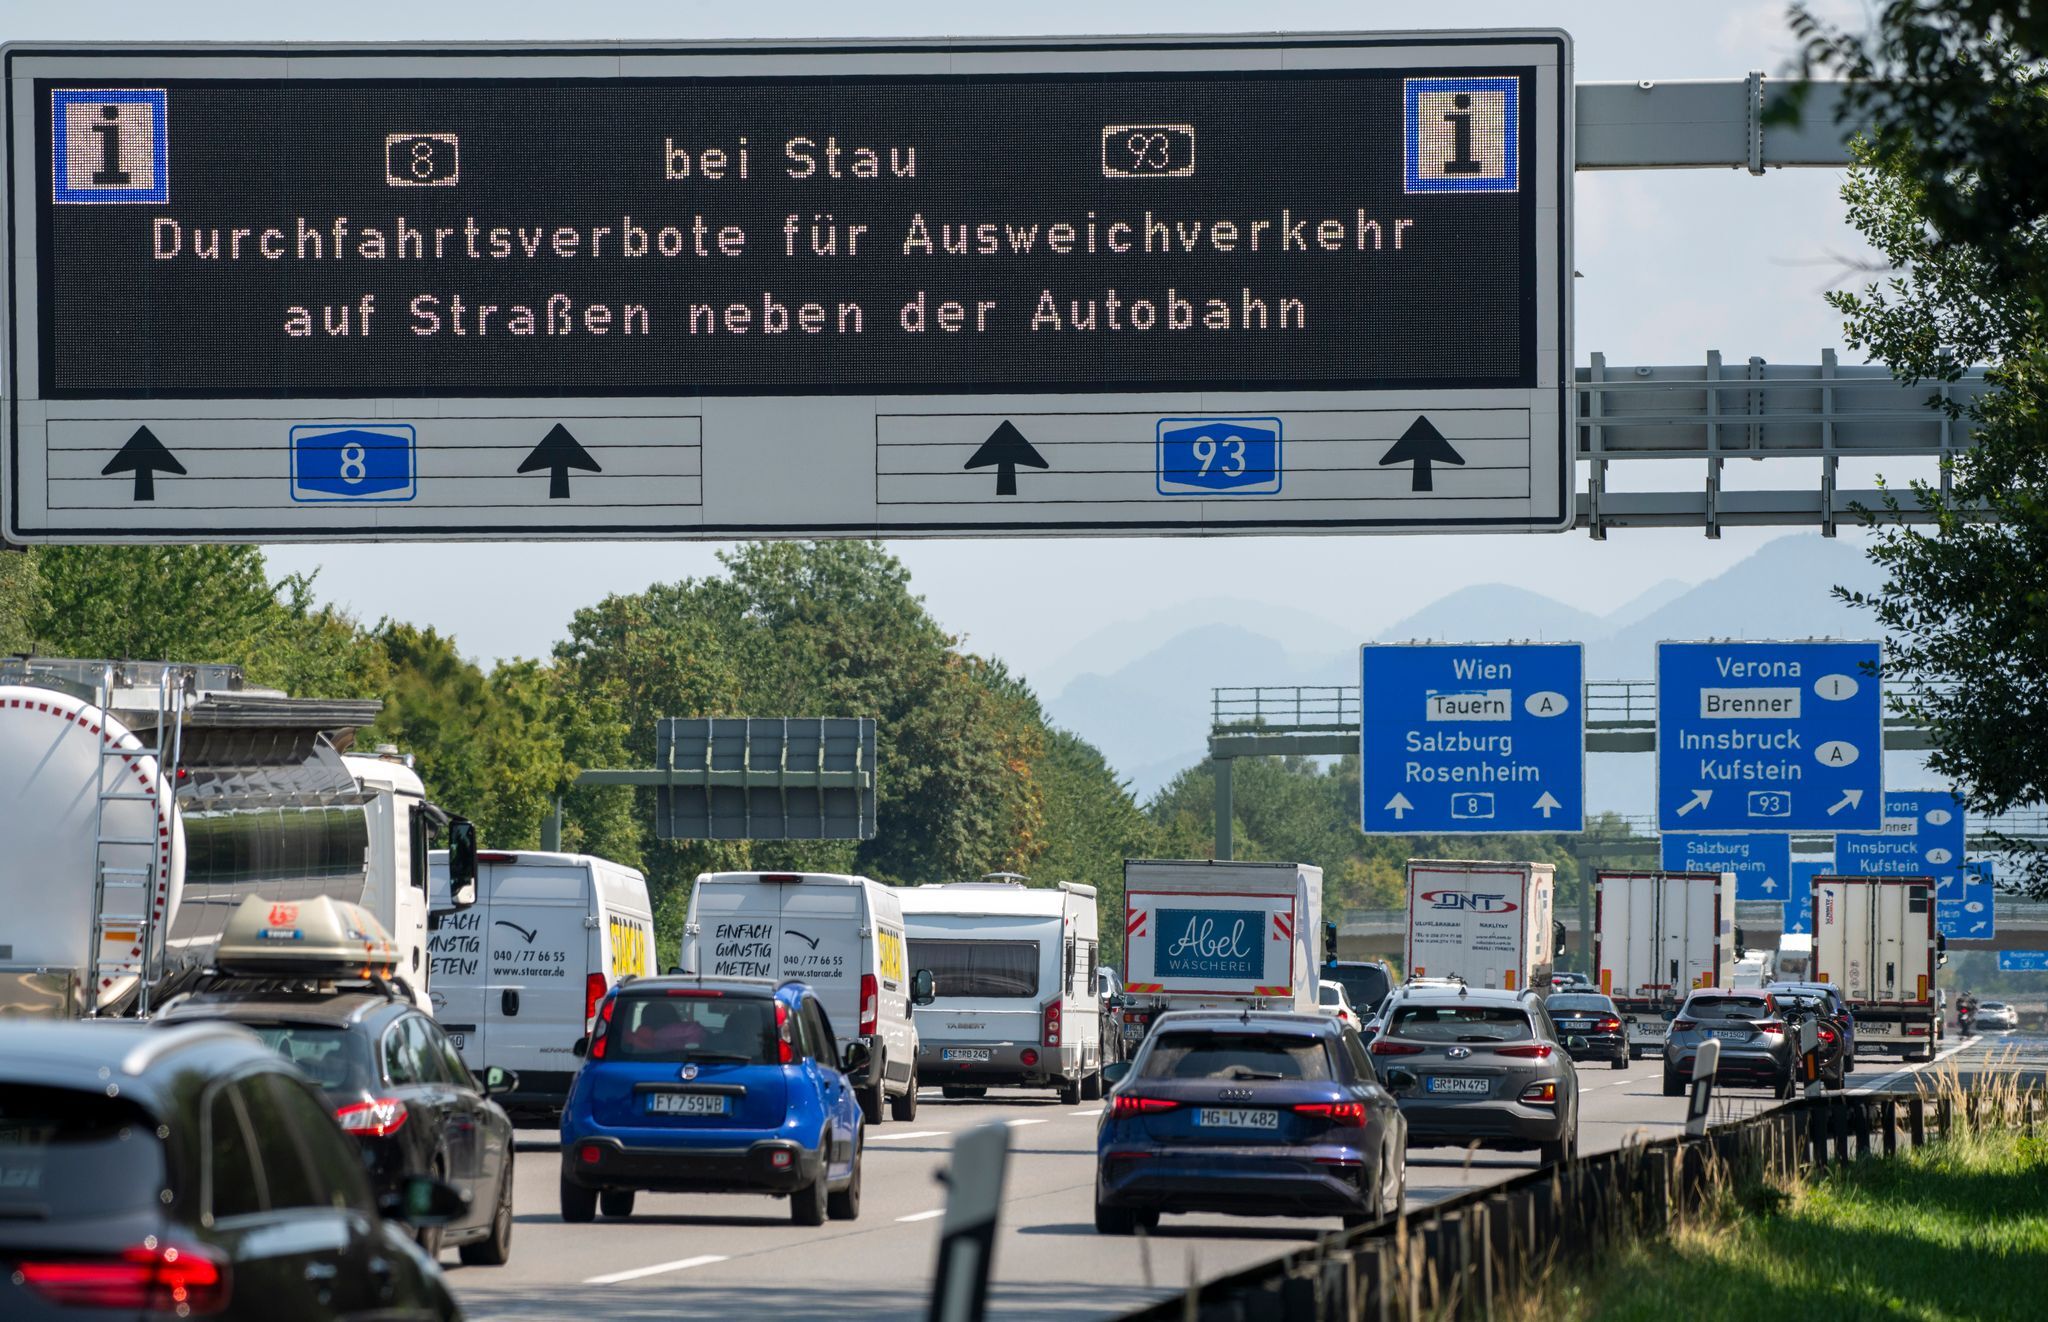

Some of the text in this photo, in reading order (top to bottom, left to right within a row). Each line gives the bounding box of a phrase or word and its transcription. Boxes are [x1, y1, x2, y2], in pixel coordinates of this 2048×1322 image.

[665, 136, 915, 180] bei Stau
[1128, 133, 1168, 169] 93
[412, 142, 433, 178] 8
[153, 208, 1414, 260] Durchfahrtsverbote für Ausweichverkehr
[283, 288, 1305, 337] auf Straßen neben der Autobahn
[341, 442, 366, 484] 8
[1193, 435, 1246, 477] 93
[1453, 658, 1512, 680] Wien
[1716, 656, 1801, 677] Verona
[1434, 696, 1505, 714] Tauern
[1540, 697, 1553, 713] A
[1707, 695, 1793, 713] Brenner
[1406, 731, 1512, 756] Salzburg
[1680, 728, 1801, 749] Innsbruck
[1830, 746, 1843, 762] A
[1406, 761, 1540, 783] Rosenheim
[1701, 759, 1801, 780] Kufstein
[1468, 798, 1478, 813] 8
[1759, 796, 1780, 812] 93
[1885, 802, 1919, 812] rona
[1885, 822, 1913, 832] nner
[1686, 841, 1750, 857] Salzburg
[1847, 841, 1919, 854] Innsbruck
[1686, 859, 1766, 872] Rosenheim
[1860, 859, 1920, 873] Kufstein
[1168, 916, 1251, 958] Abel
[493, 950, 565, 963] 040 / 77 66 55
[783, 955, 843, 966] 040 / 77 66 55
[493, 966, 565, 977] www.starcar.de
[783, 968, 843, 978] www.starcar.de
[1169, 959, 1250, 972] WÄSCHEREI
[948, 1050, 957, 1058] SE
[974, 1050, 988, 1058] 245
[1433, 1078, 1487, 1090] GR PN 475
[656, 1095, 723, 1112] FY 759WB
[1201, 1110, 1277, 1127] HG LY 482
